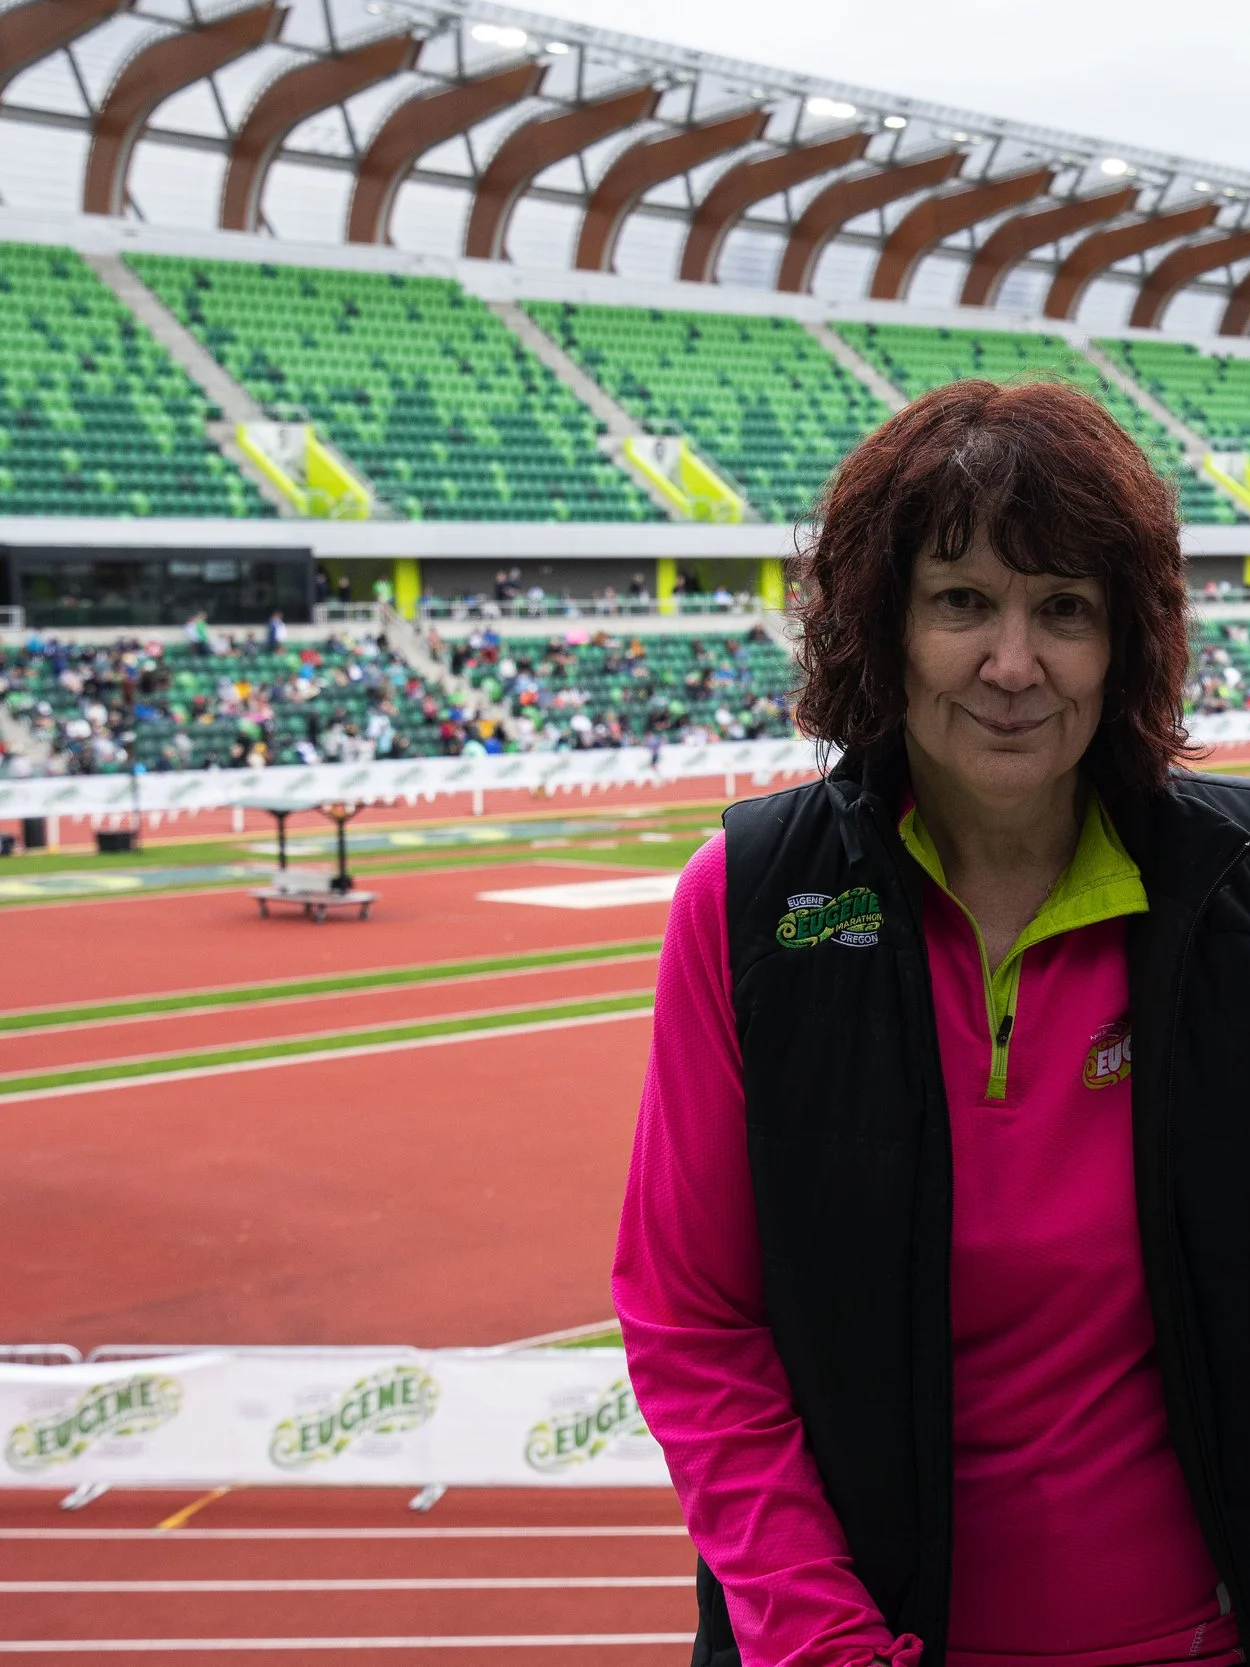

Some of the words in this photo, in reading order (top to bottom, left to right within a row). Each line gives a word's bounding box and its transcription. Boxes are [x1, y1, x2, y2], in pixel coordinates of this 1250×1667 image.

[787, 896, 824, 908] EUGENE
[796, 894, 881, 939] EUGENE
[835, 912, 883, 932] MARATHON
[839, 933, 878, 944] OREGON
[36, 1380, 158, 1456] EUGENE
[301, 1375, 417, 1452] EUGENE
